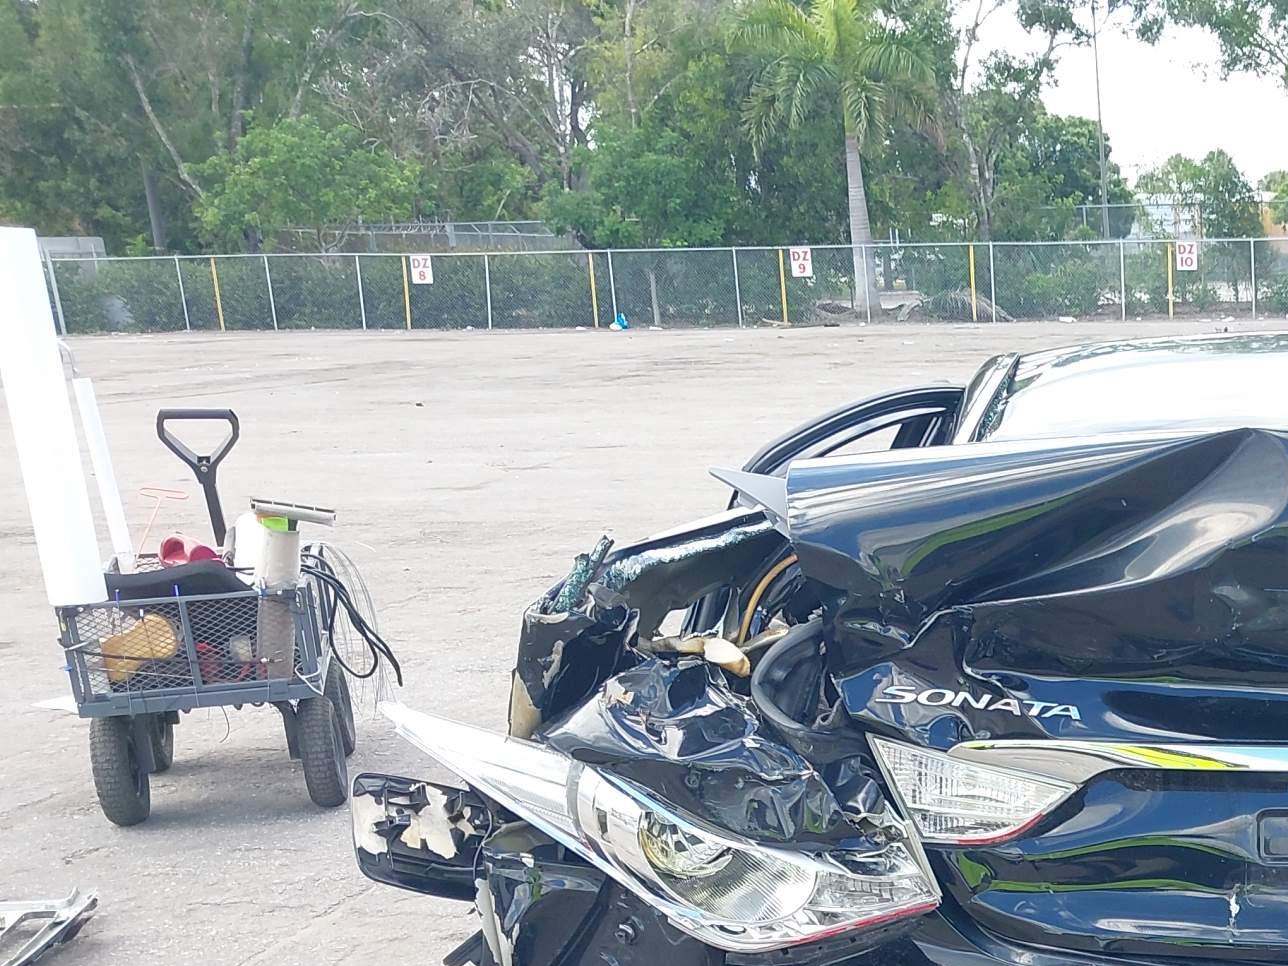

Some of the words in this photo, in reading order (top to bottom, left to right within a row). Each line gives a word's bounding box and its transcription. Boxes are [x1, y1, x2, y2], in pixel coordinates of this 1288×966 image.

[1178, 244, 1195, 255] DZ
[791, 250, 810, 262] DZ
[1180, 256, 1194, 267] 10
[411, 257, 430, 269] DZ
[798, 263, 806, 274] 9
[418, 270, 426, 281] 8
[875, 685, 1082, 721] SONATA
